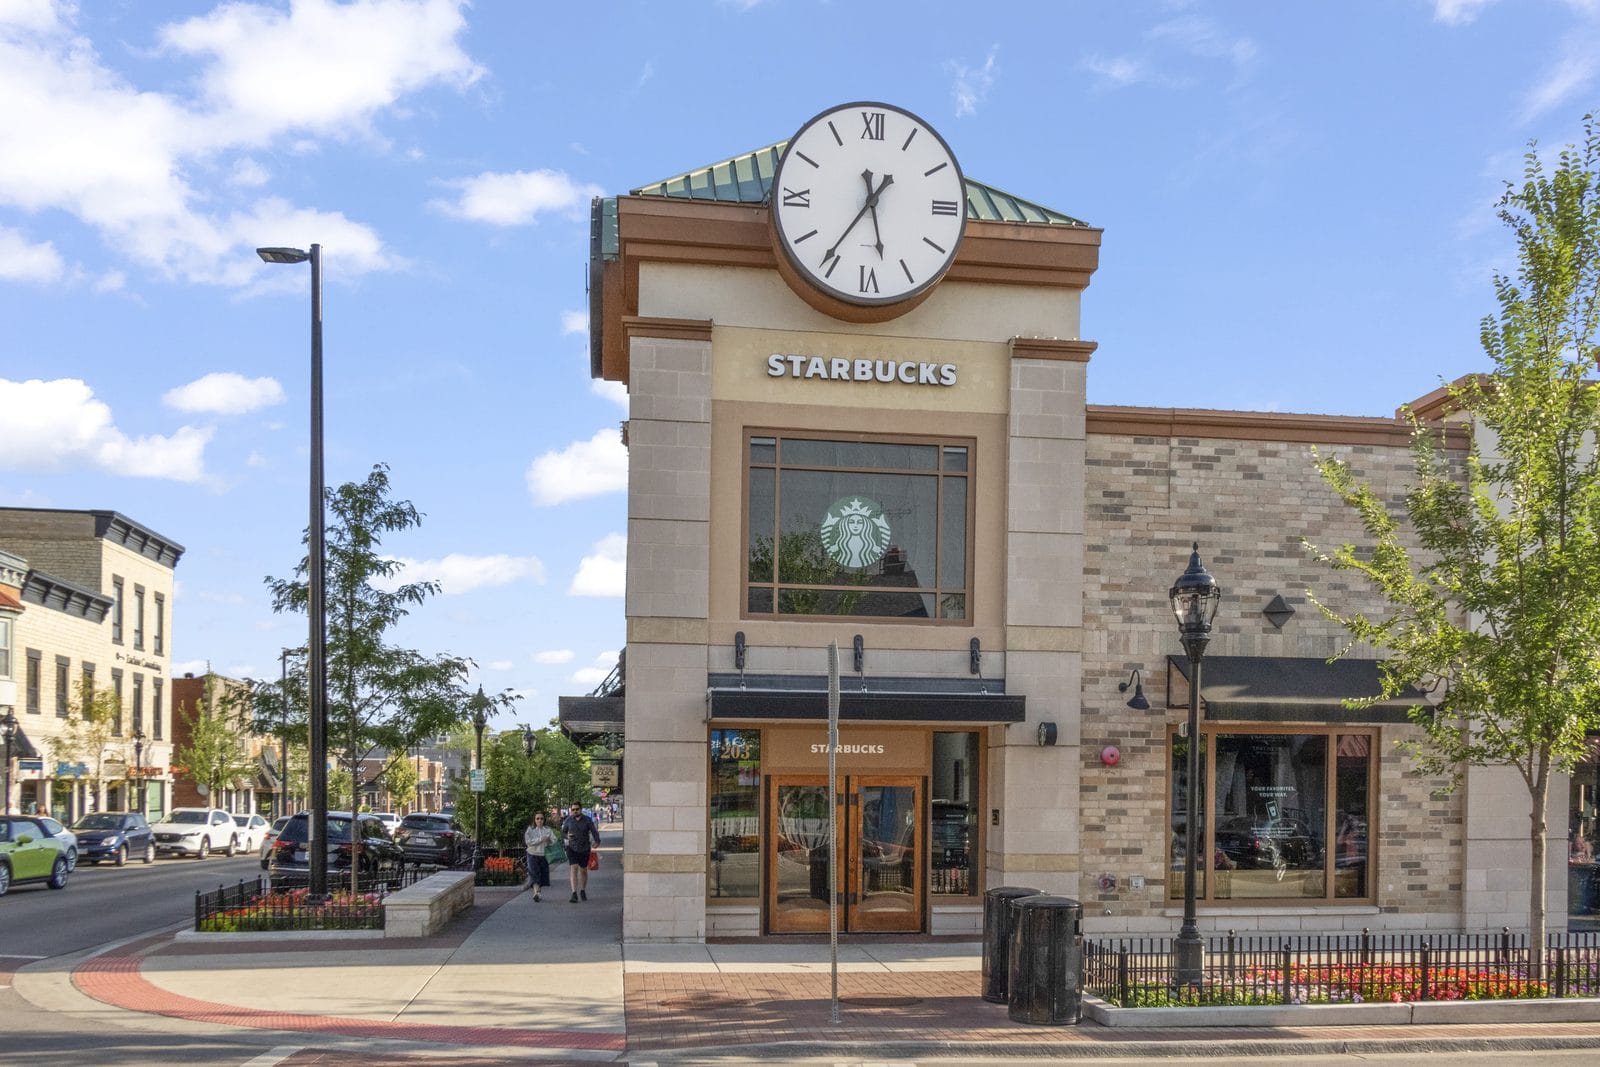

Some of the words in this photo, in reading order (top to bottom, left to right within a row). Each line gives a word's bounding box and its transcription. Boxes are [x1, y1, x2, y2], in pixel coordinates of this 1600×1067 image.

[861, 112, 885, 140] XII
[784, 187, 810, 208] IX
[932, 200, 957, 216] III
[859, 265, 880, 293] VI
[767, 353, 957, 386] STARBUCKS
[721, 744, 752, 759] 203
